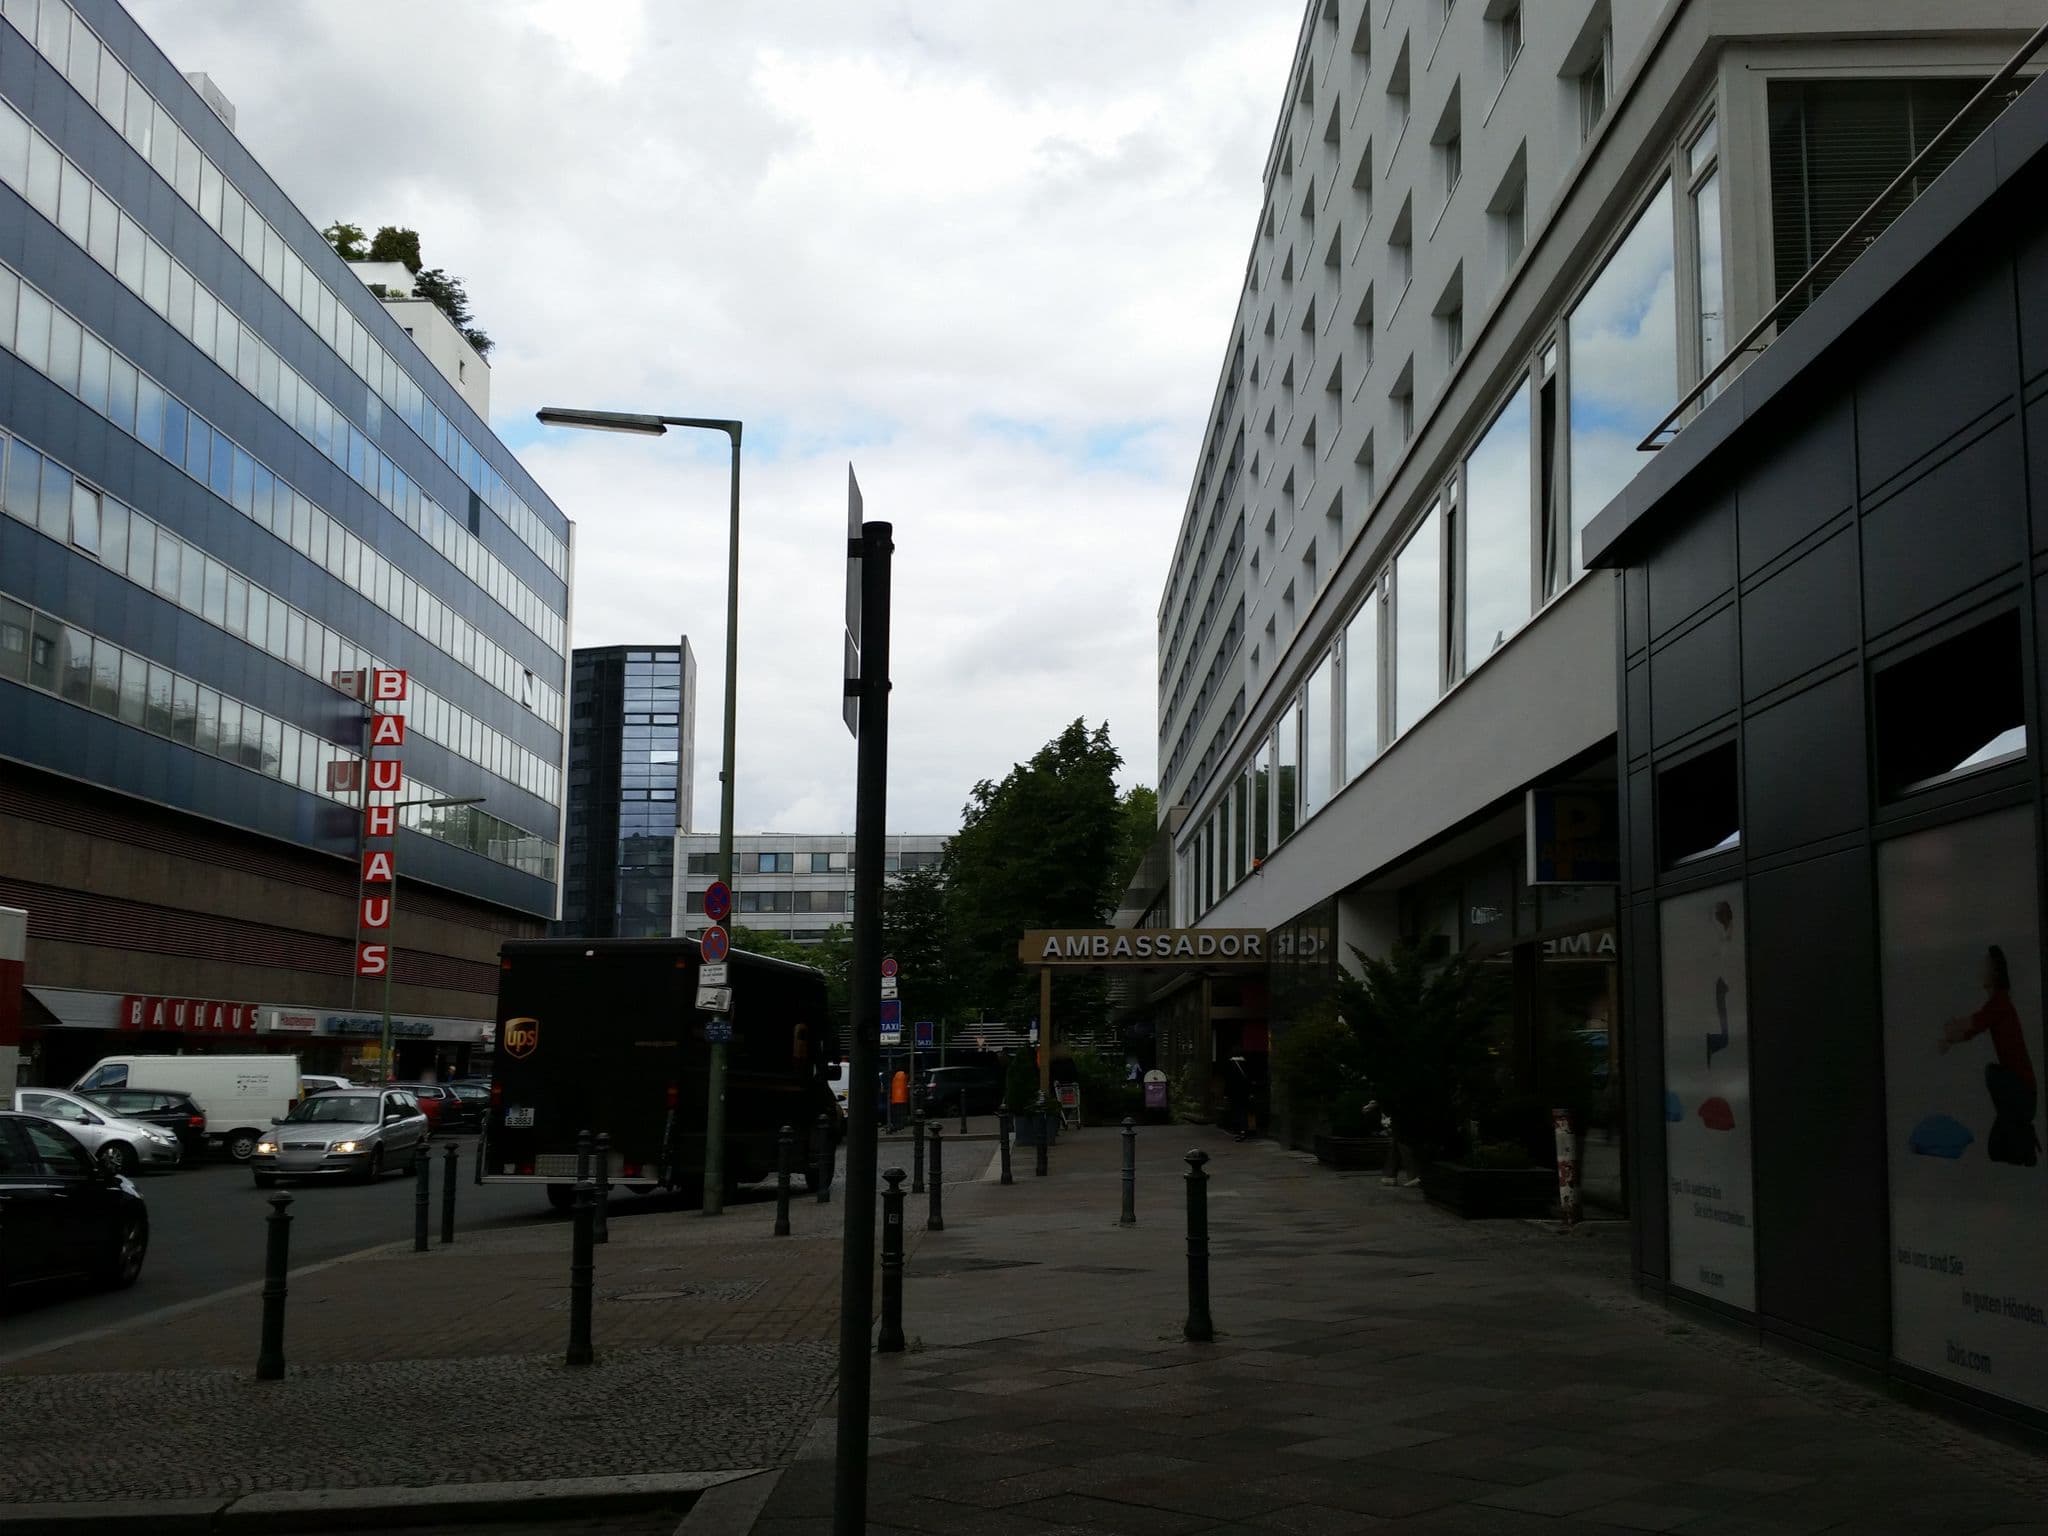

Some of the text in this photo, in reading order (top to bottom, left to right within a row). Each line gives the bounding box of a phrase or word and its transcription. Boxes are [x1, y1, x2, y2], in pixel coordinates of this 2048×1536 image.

[359, 672, 404, 974] BAUHAUS
[1041, 933, 1262, 958] AMBASSADOR
[130, 1000, 258, 1030] BAUHAUS
[507, 1029, 536, 1051] ups
[881, 1023, 899, 1033] TAXI
[1973, 1291, 2001, 1314] guten
